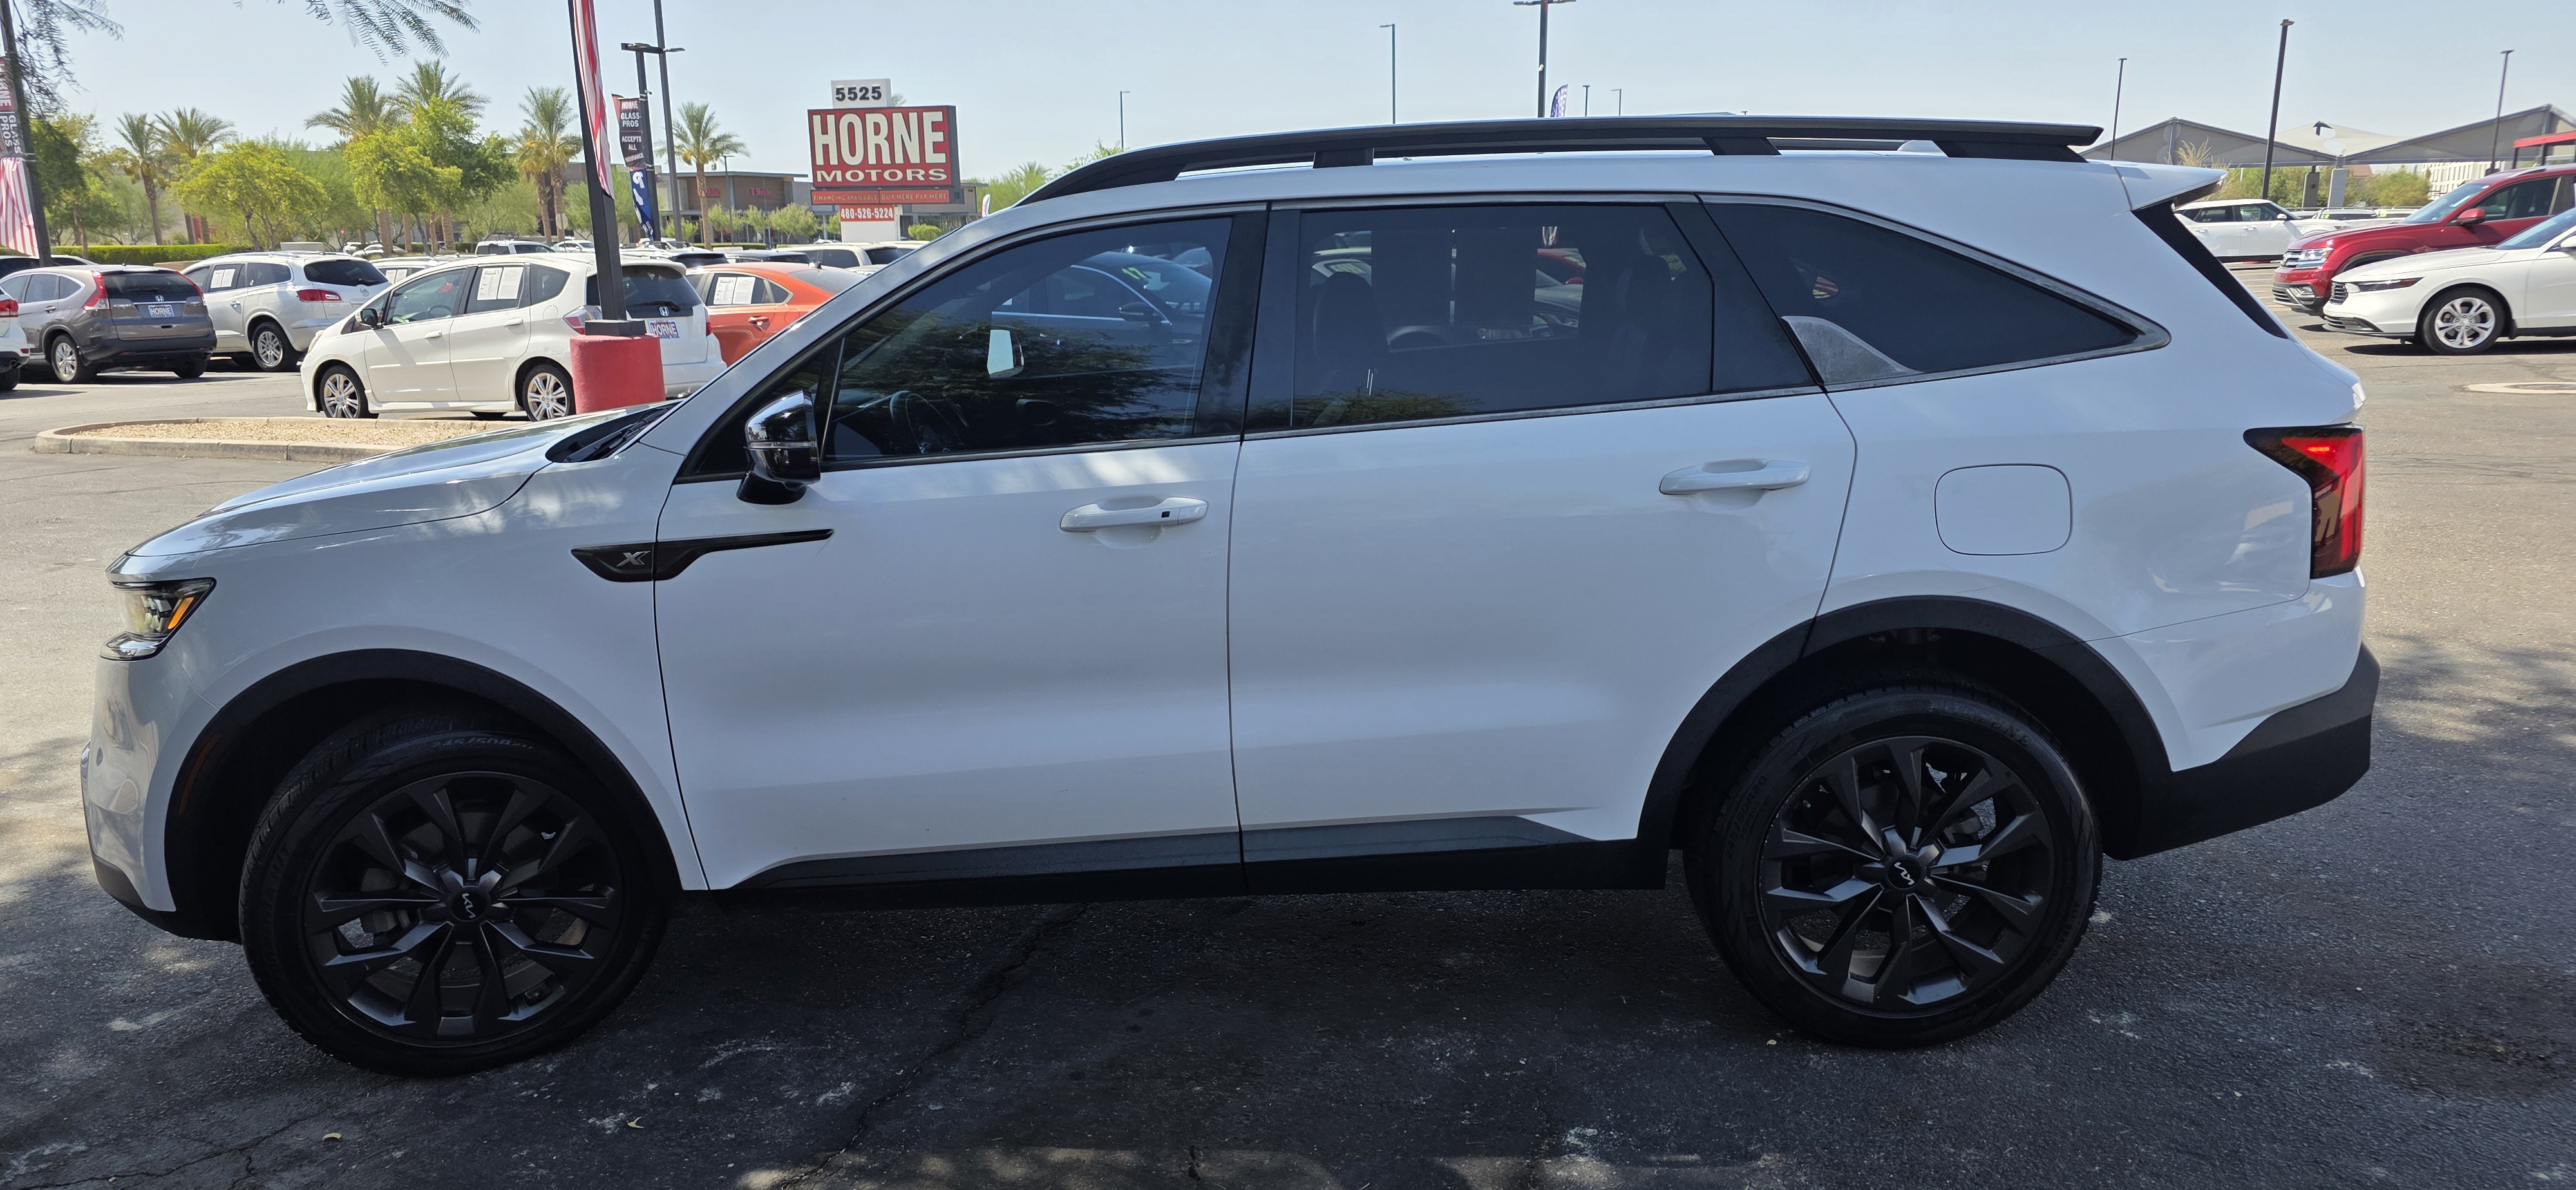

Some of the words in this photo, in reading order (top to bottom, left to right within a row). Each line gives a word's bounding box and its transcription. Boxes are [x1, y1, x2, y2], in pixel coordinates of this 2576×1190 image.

[835, 85, 882, 101] 5525
[621, 100, 638, 109] HORNE
[0, 115, 13, 147] PROS
[813, 111, 946, 165] HORNE
[817, 169, 947, 182] MOTORS
[840, 207, 893, 219] 480-526-5224
[151, 307, 172, 316] HORNE
[651, 323, 677, 335] HORNE
